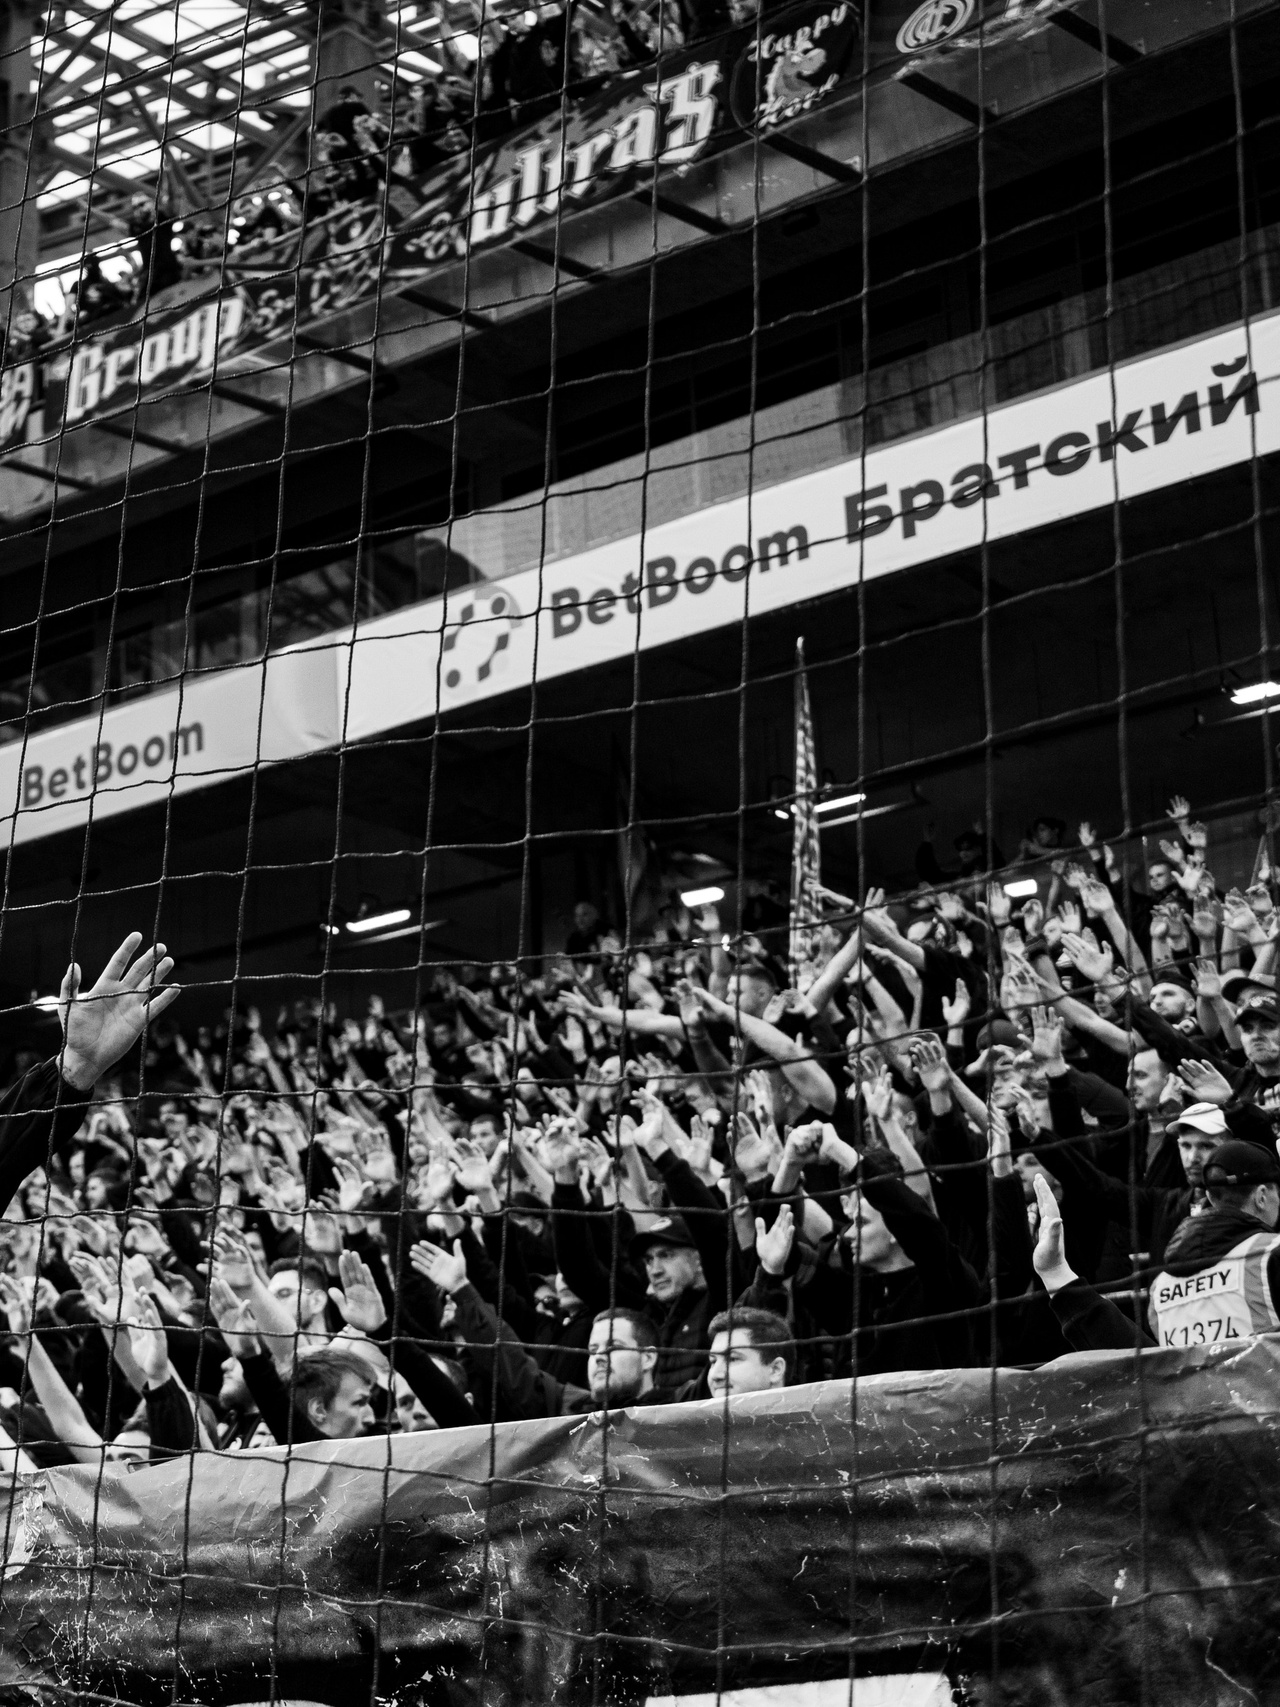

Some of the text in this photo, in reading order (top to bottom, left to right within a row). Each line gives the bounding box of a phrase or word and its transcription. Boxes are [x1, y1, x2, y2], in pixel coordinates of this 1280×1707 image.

[551, 354, 1261, 639] BetBoom Братский
[24, 722, 204, 808] BetBoom
[1159, 1268, 1232, 1304] SAFETY
[1163, 1316, 1240, 1346] K1374
